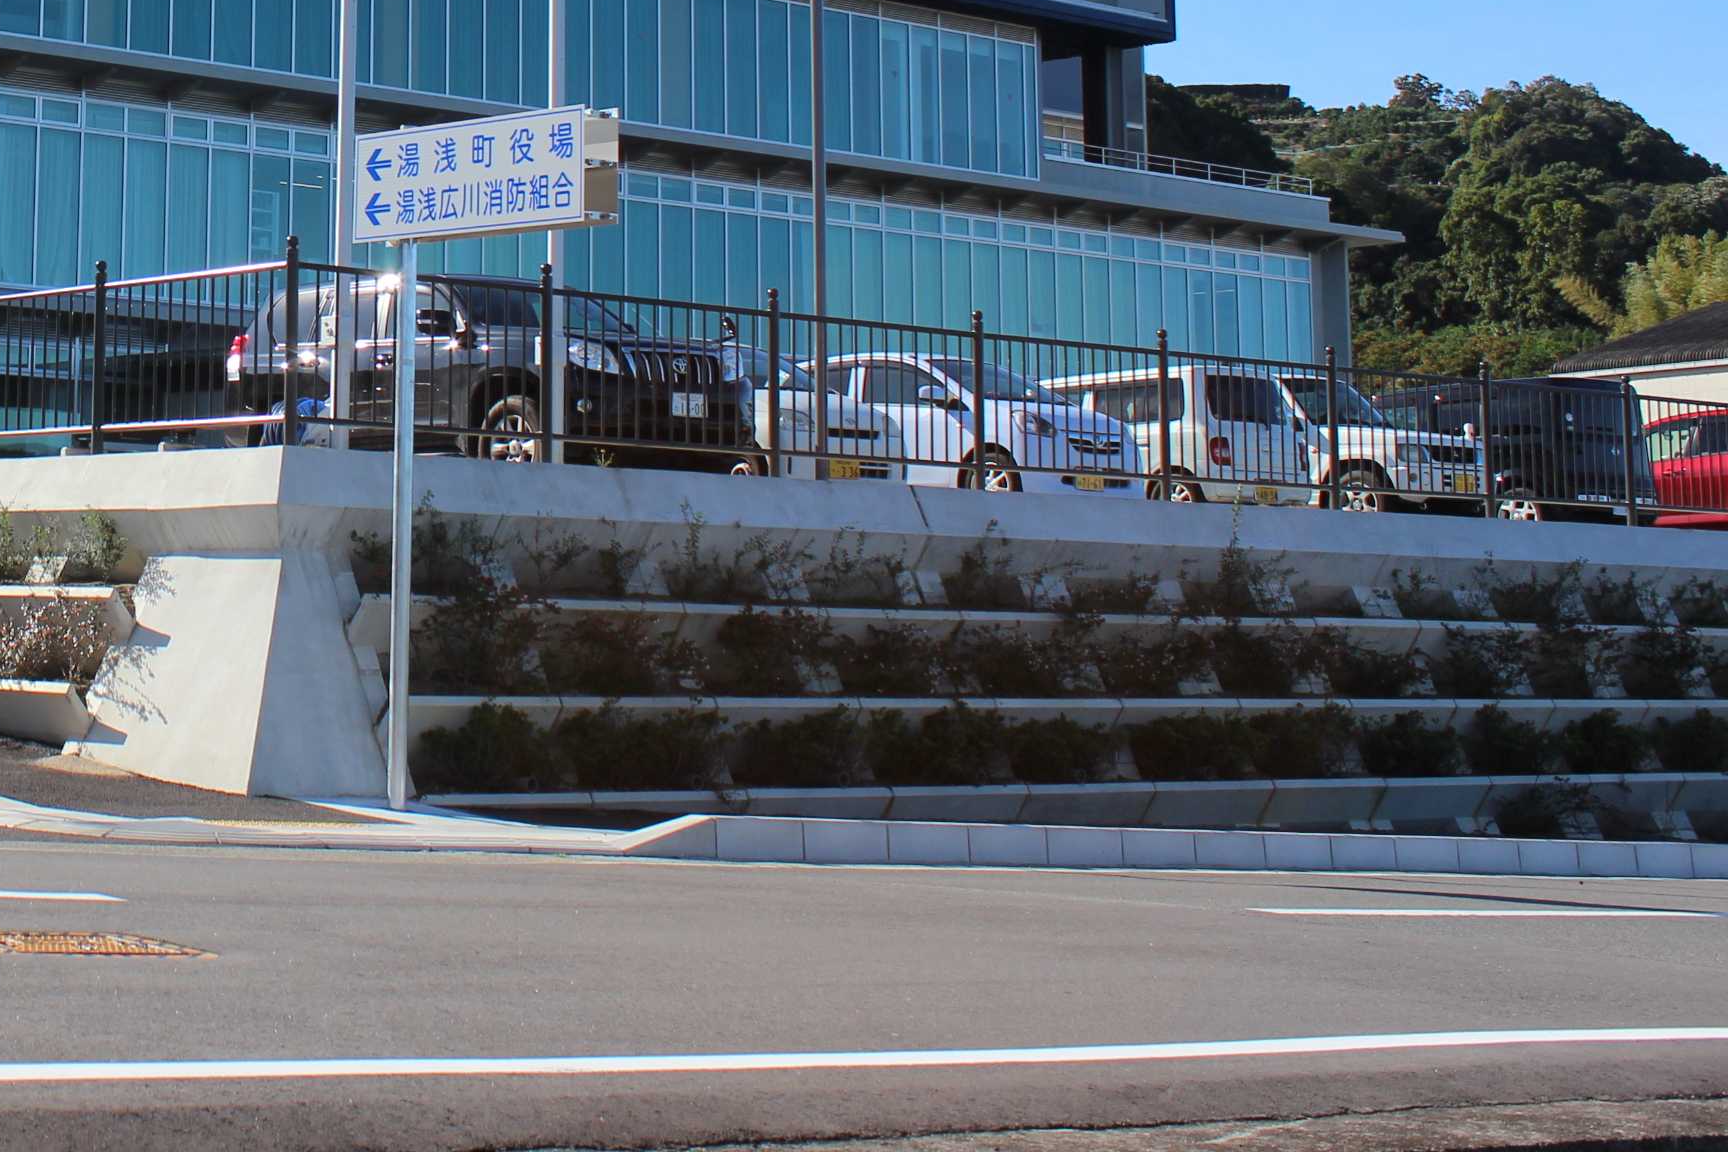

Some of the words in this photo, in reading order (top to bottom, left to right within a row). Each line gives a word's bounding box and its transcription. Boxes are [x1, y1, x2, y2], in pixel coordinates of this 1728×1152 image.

[397, 123, 574, 178] 湯浅町役場
[396, 172, 573, 224] 湯浅広川消防組合
